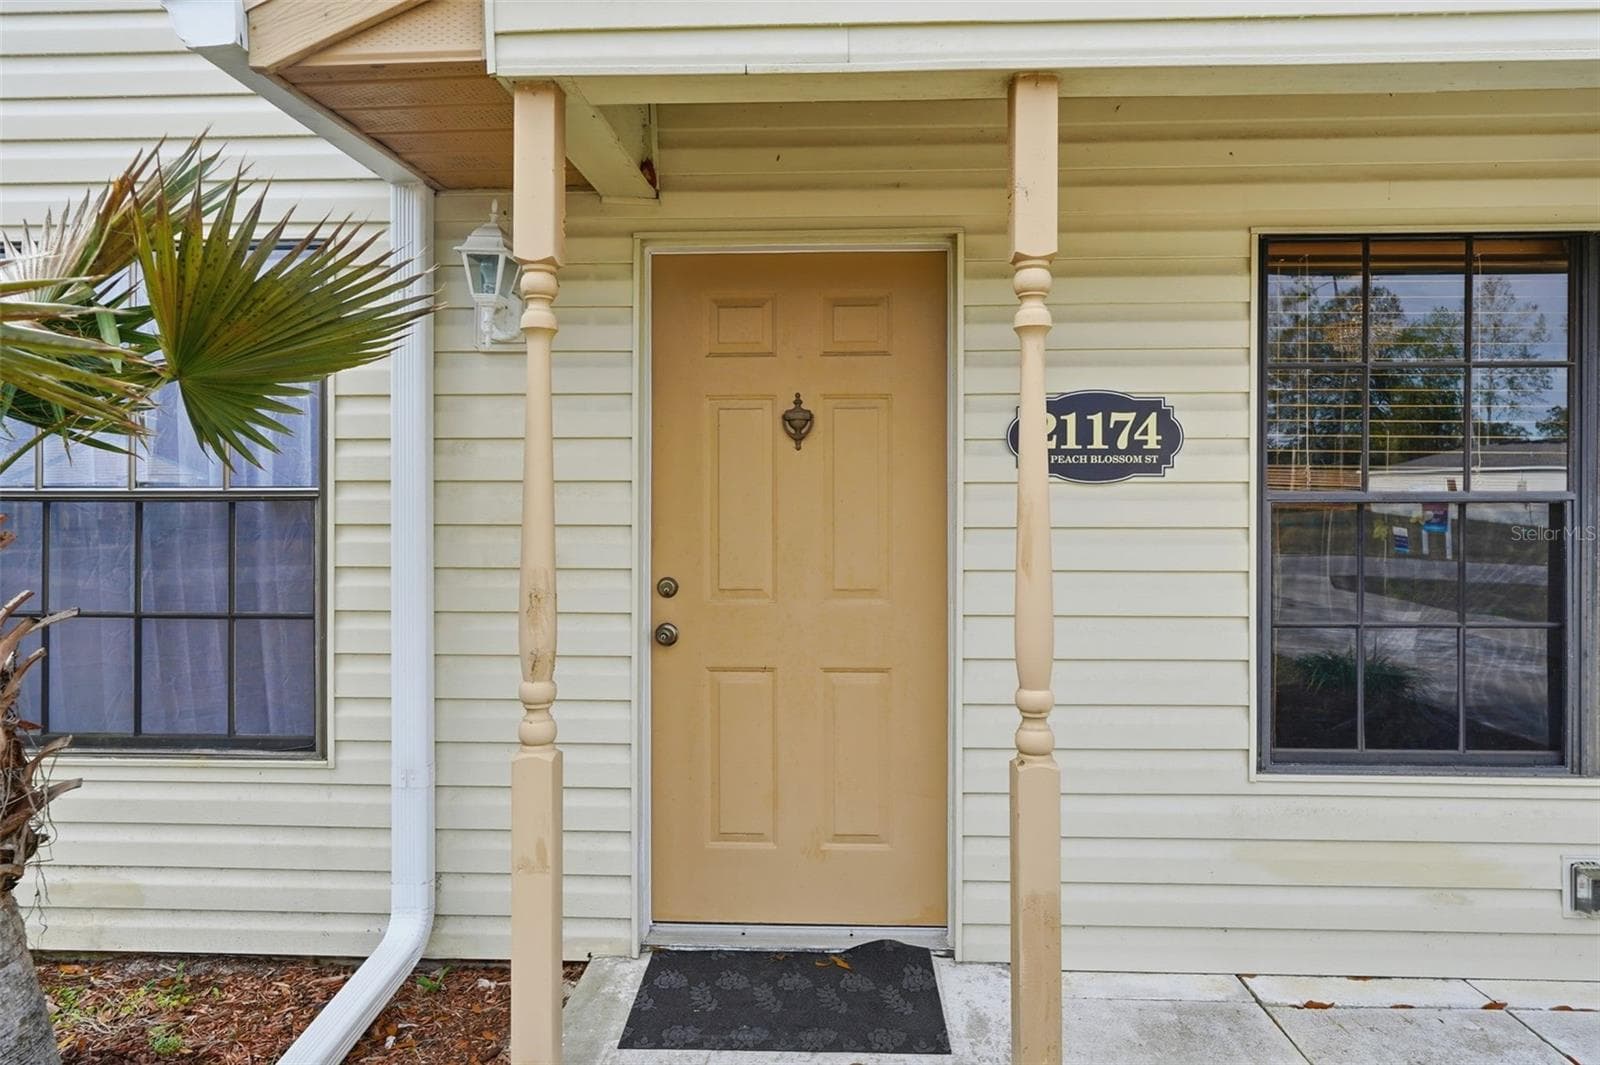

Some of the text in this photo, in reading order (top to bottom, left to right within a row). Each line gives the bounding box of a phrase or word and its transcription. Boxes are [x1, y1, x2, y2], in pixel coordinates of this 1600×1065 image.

[1050, 454, 1159, 464] PEACH BLOSSOM ST
